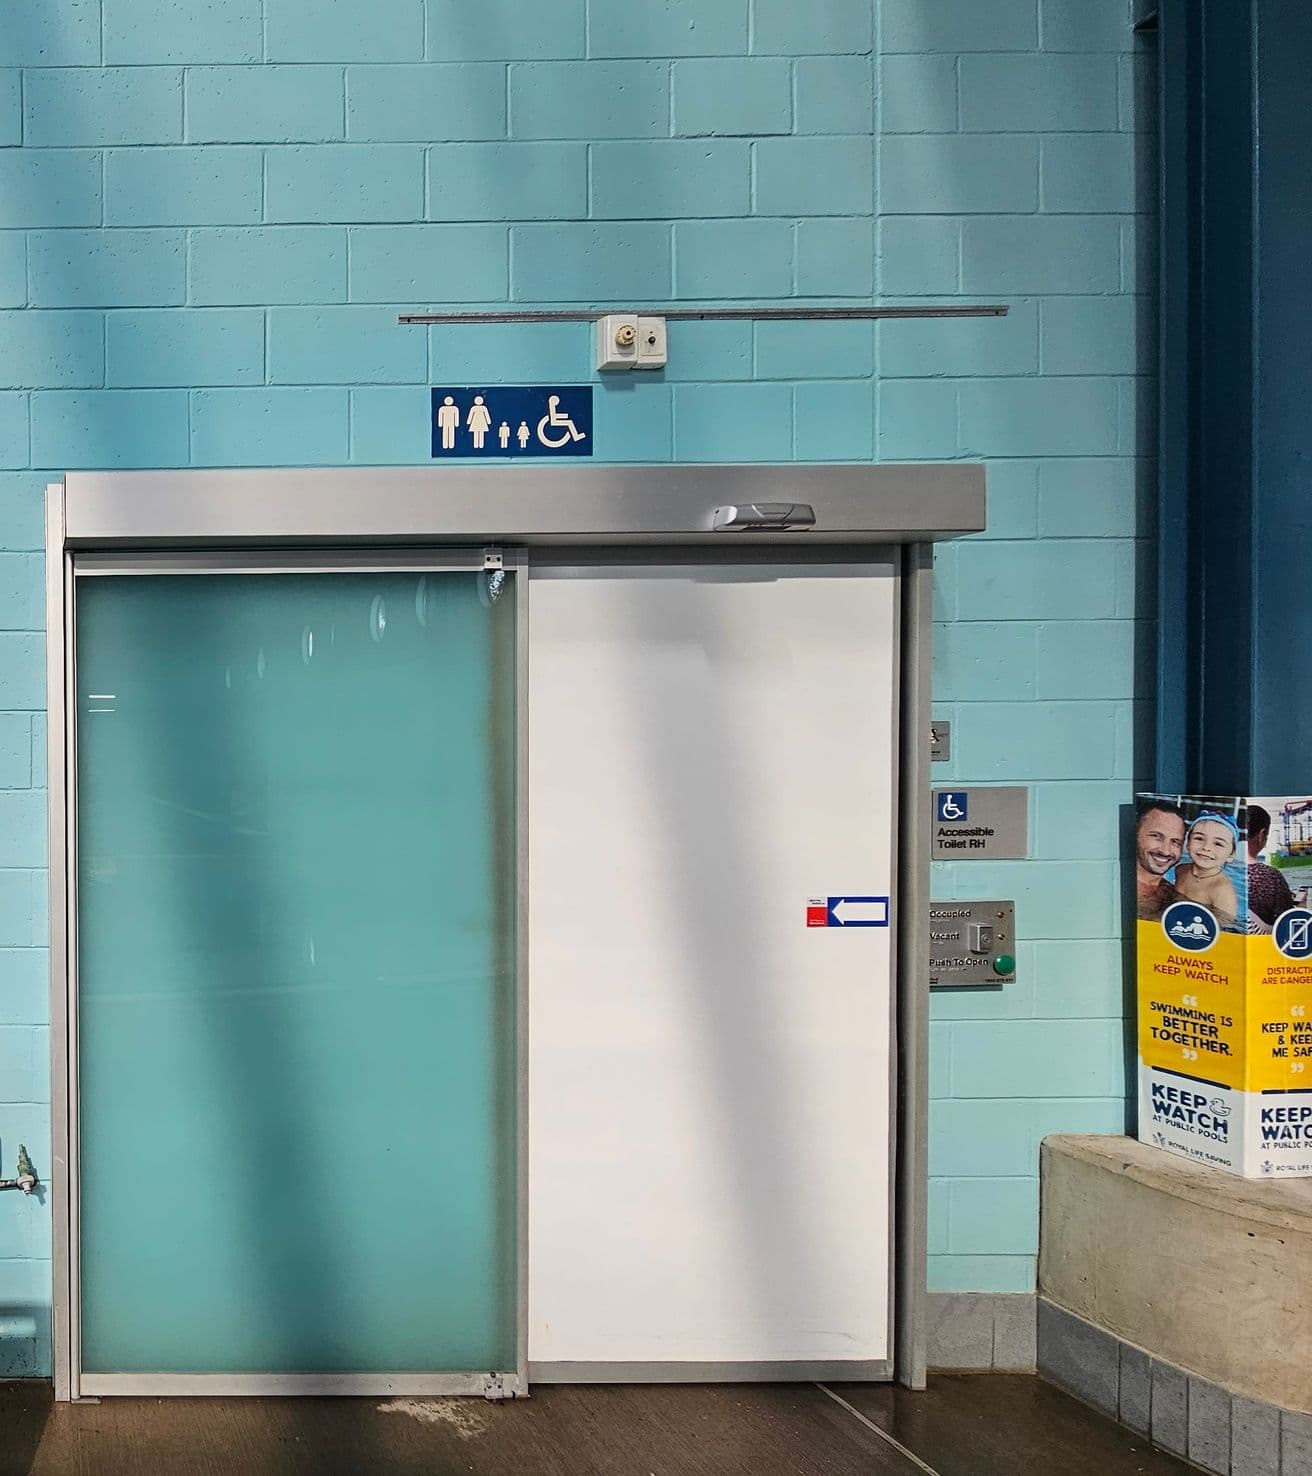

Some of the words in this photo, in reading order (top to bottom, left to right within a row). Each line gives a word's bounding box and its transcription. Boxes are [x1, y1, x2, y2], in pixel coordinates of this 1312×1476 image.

[937, 826, 995, 837] Accessible
[937, 839, 967, 849] Toilet
[969, 839, 986, 848] RH
[929, 910, 971, 918] Occupied
[930, 932, 960, 940] Vacant
[929, 958, 952, 966] Push
[953, 958, 965, 966] To
[965, 957, 989, 967] Open
[1167, 955, 1214, 971] ALWAYS
[1153, 963, 1181, 976] KEEP
[1185, 969, 1229, 985] WATCH
[1267, 966, 1312, 975] DISTRACTI
[1261, 977, 1278, 985] ARE
[1280, 976, 1312, 985] DANGE
[1150, 1001, 1216, 1024] SWIMMING
[1220, 1016, 1233, 1027] IS
[1163, 1016, 1219, 1039] BETTER
[1261, 1022, 1289, 1034] KEEP
[1150, 1026, 1233, 1057] TOGETHER.
[1277, 1035, 1285, 1045] &
[1290, 1034, 1312, 1045] KEE
[1272, 1047, 1289, 1058] ME
[1152, 1082, 1208, 1109] KEEP
[1152, 1098, 1229, 1135] WATCH
[1261, 1106, 1312, 1123] KEEP
[1153, 1114, 1162, 1122] AT
[1166, 1118, 1195, 1133] PUBLIC
[1198, 1128, 1228, 1144] POOLS
[1261, 1142, 1271, 1150] AT
[1273, 1141, 1302, 1149] PUBLIC
